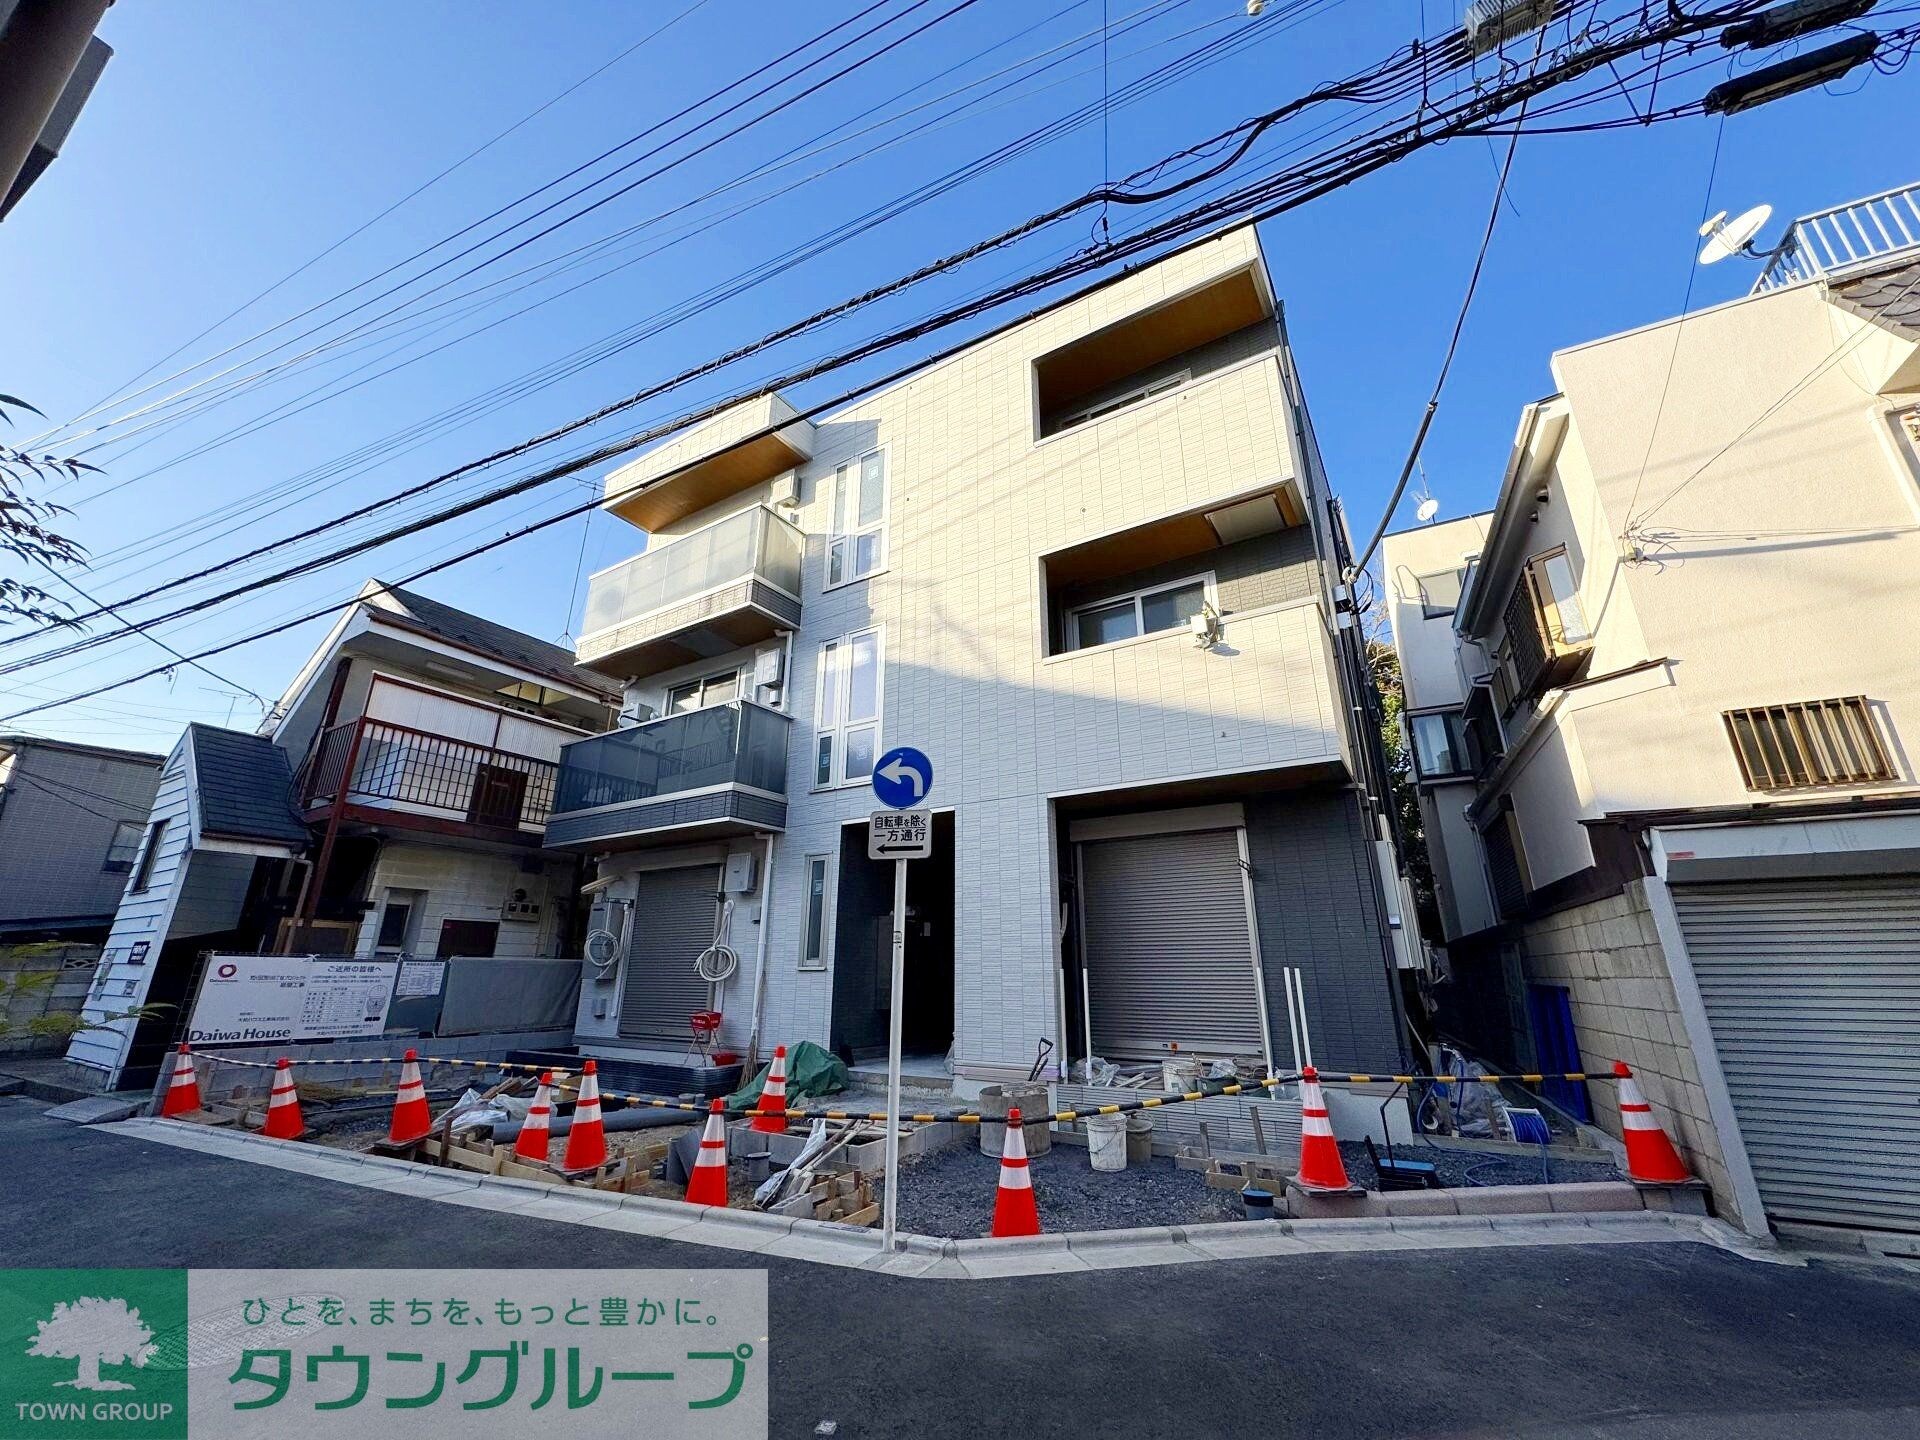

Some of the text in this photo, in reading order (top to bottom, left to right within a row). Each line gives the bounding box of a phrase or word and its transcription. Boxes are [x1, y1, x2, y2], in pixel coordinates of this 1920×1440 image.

[875, 815, 926, 828] 自転車を除く
[874, 829, 926, 842] 一方通行
[328, 965, 382, 973] ご近所の皆様へ
[190, 1028, 291, 1042] Daiwa House
